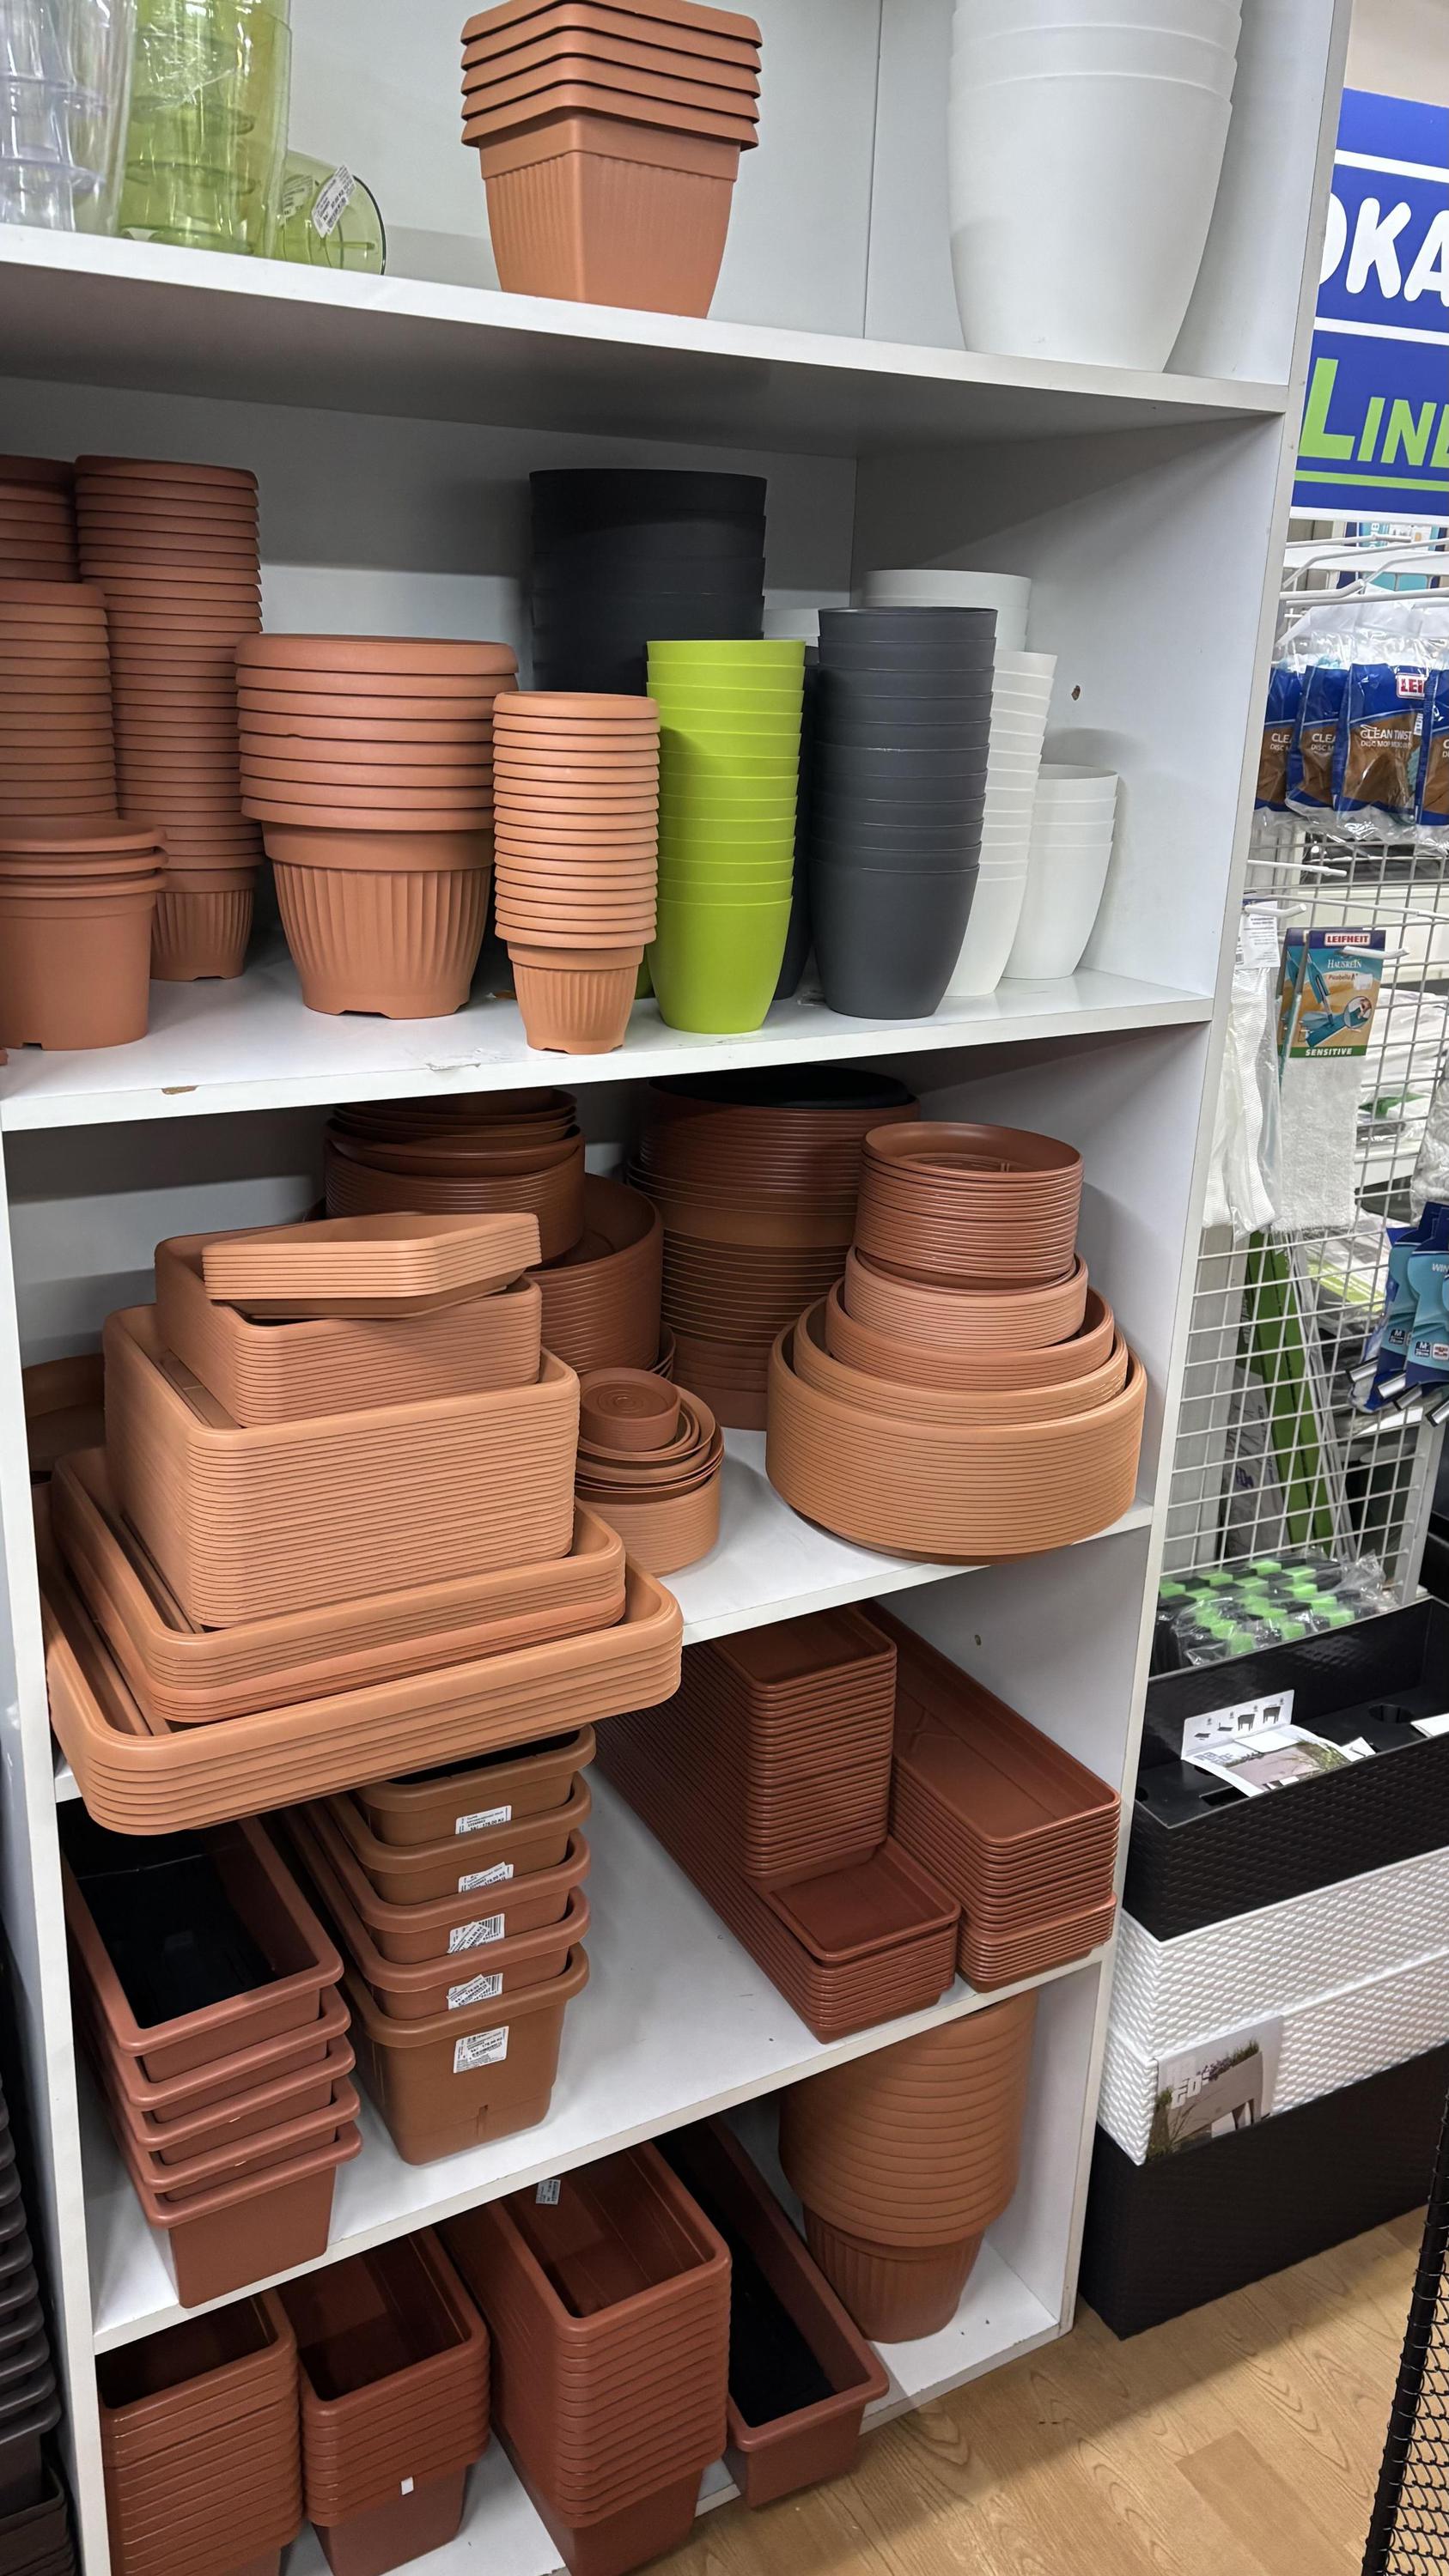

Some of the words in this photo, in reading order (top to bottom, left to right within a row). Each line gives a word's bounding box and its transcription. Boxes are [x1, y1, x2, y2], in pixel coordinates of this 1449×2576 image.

[1272, 732, 1292, 744] CLE
[1360, 729, 1393, 739] CLEAN
[1393, 730, 1413, 740] TWIST
[1306, 1048, 1353, 1056] SENSITIVE
